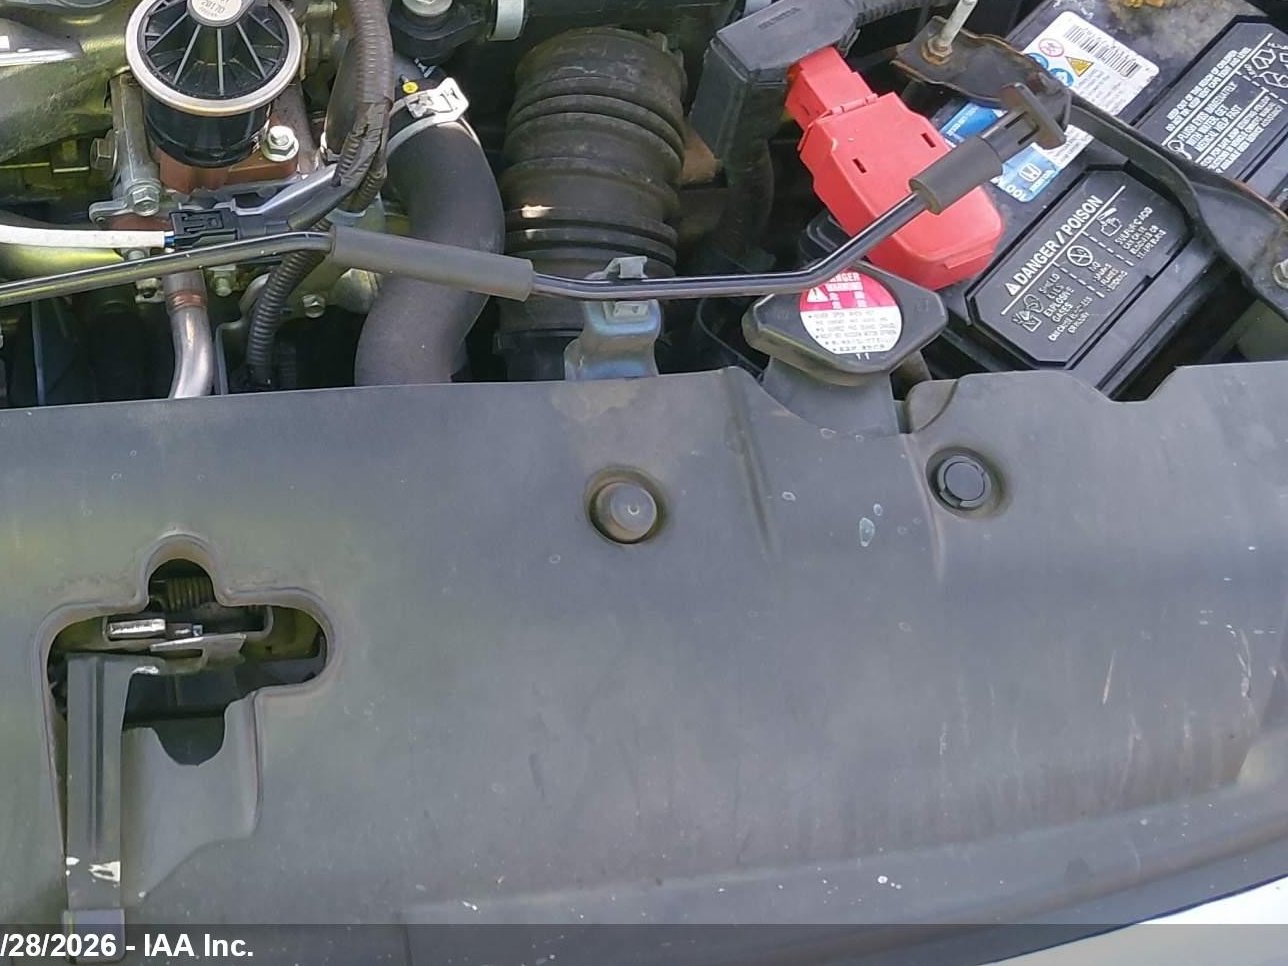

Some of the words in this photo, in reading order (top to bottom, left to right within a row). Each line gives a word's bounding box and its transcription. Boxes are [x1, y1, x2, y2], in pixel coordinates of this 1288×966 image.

[1176, 123, 1197, 141] FLUSH
[1193, 129, 1219, 152] MEDICAL
[1012, 239, 1060, 285] DANGER
[1059, 193, 1104, 235] POISON
[830, 272, 860, 283] ANGER
[1042, 285, 1075, 318] EXPLOSIVE
[1050, 300, 1074, 324] GASES
